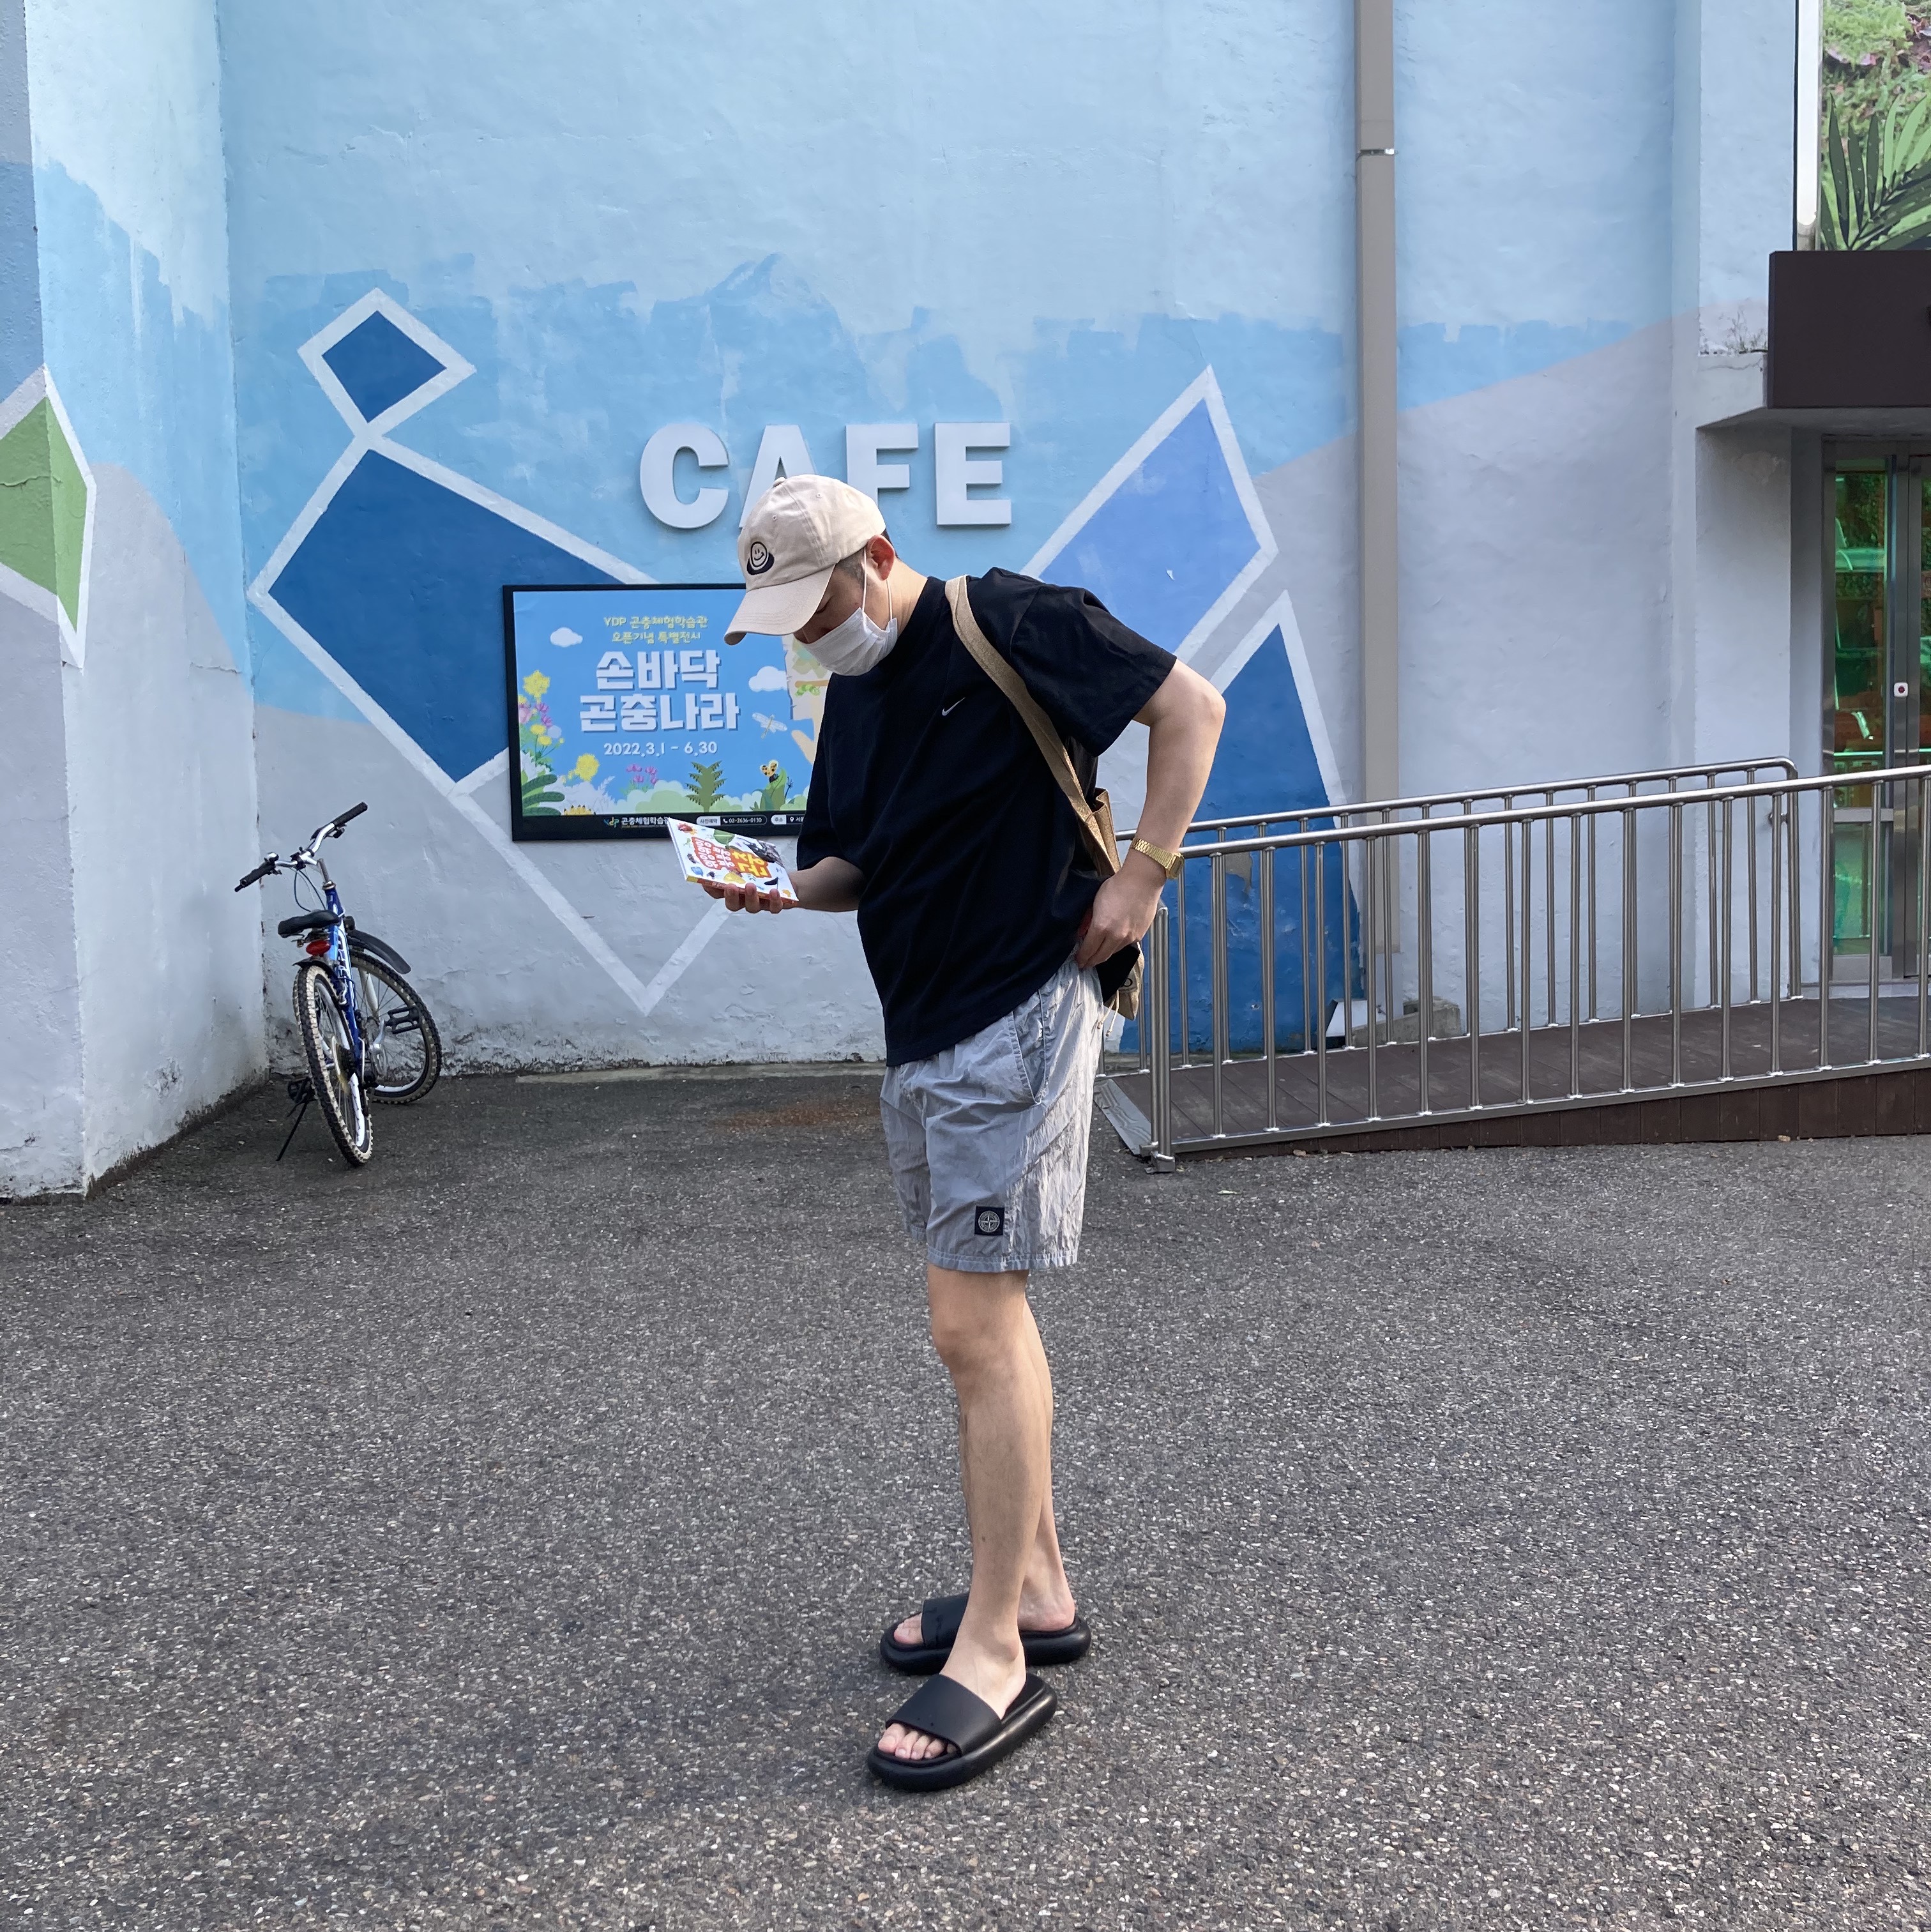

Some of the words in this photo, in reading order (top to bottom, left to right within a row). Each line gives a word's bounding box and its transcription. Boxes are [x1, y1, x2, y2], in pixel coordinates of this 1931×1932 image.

[640, 422, 1012, 529] CAFE
[603, 616, 627, 627] YDP
[630, 615, 708, 630] 곤충체험학습관
[612, 631, 655, 644] 오픈기념
[658, 631, 702, 644] 특별전시
[596, 650, 721, 690] 손바닥
[580, 692, 740, 732] 곤충나라
[684, 741, 718, 757] 6.30
[731, 850, 769, 877] 곤충
